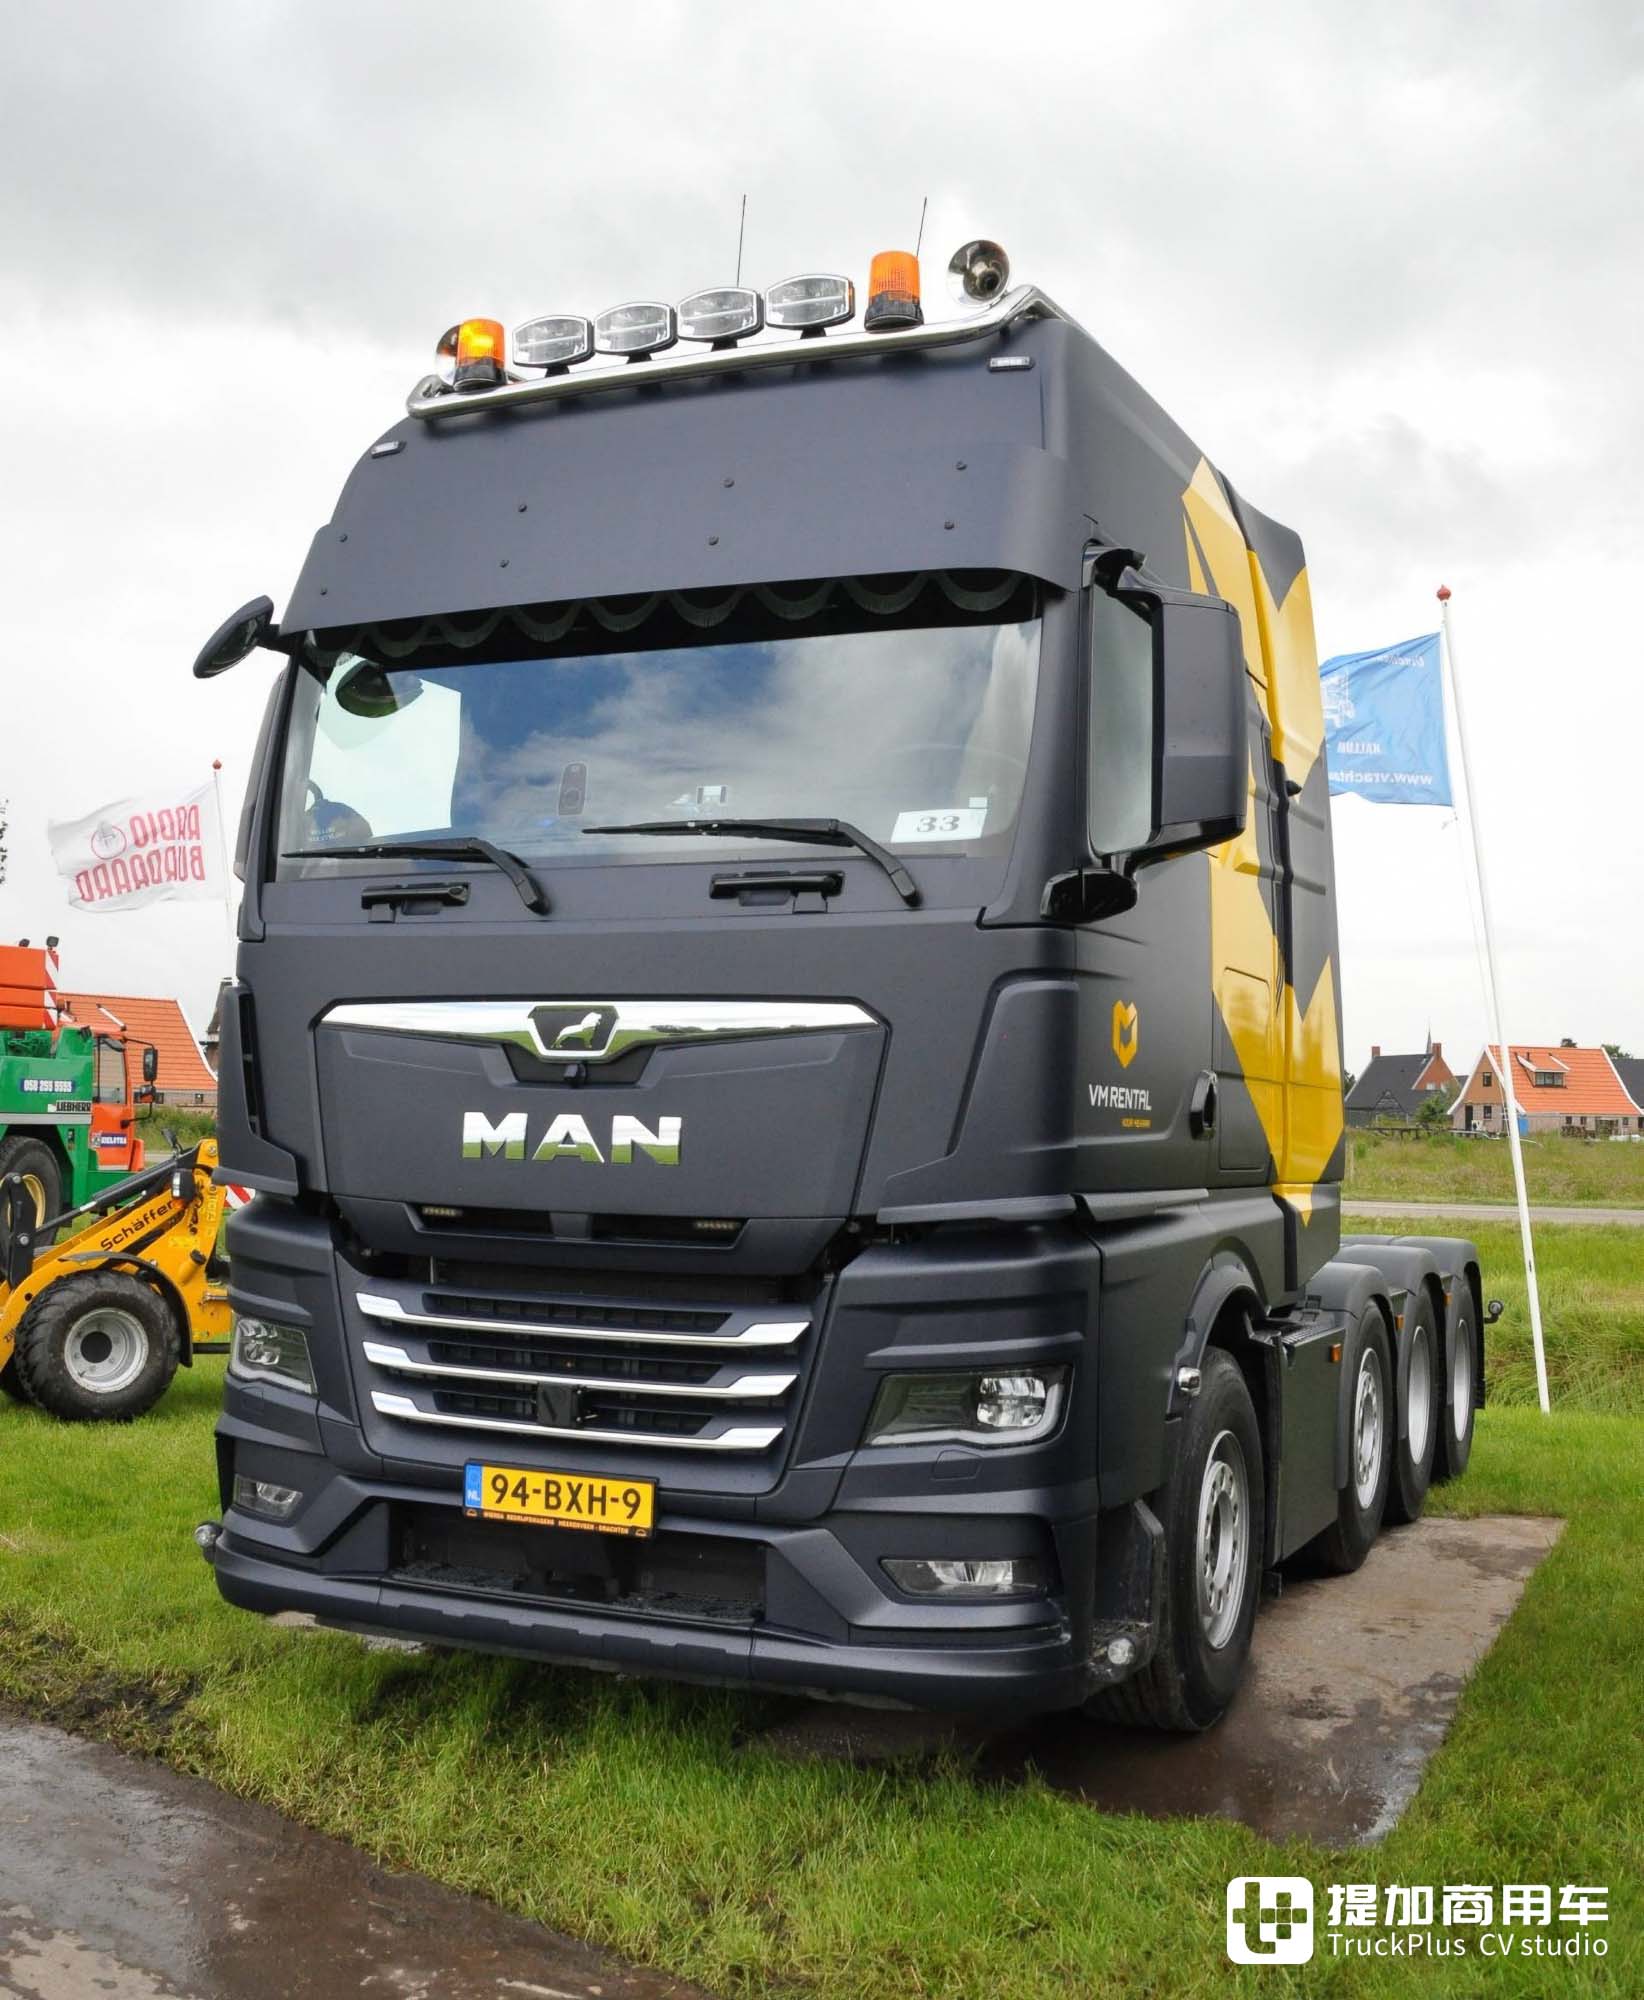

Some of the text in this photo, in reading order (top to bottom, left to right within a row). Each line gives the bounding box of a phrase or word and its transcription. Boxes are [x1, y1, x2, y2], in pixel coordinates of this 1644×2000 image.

[917, 815, 960, 832] 33
[56, 1101, 91, 1112] LIEBHERR
[1088, 1084, 1152, 1110] VM RENTAL
[462, 1111, 682, 1166] MAN
[100, 1201, 174, 1251] Schäffer
[467, 1490, 481, 1501] NL
[491, 1473, 641, 1519] 94-BXH-9
